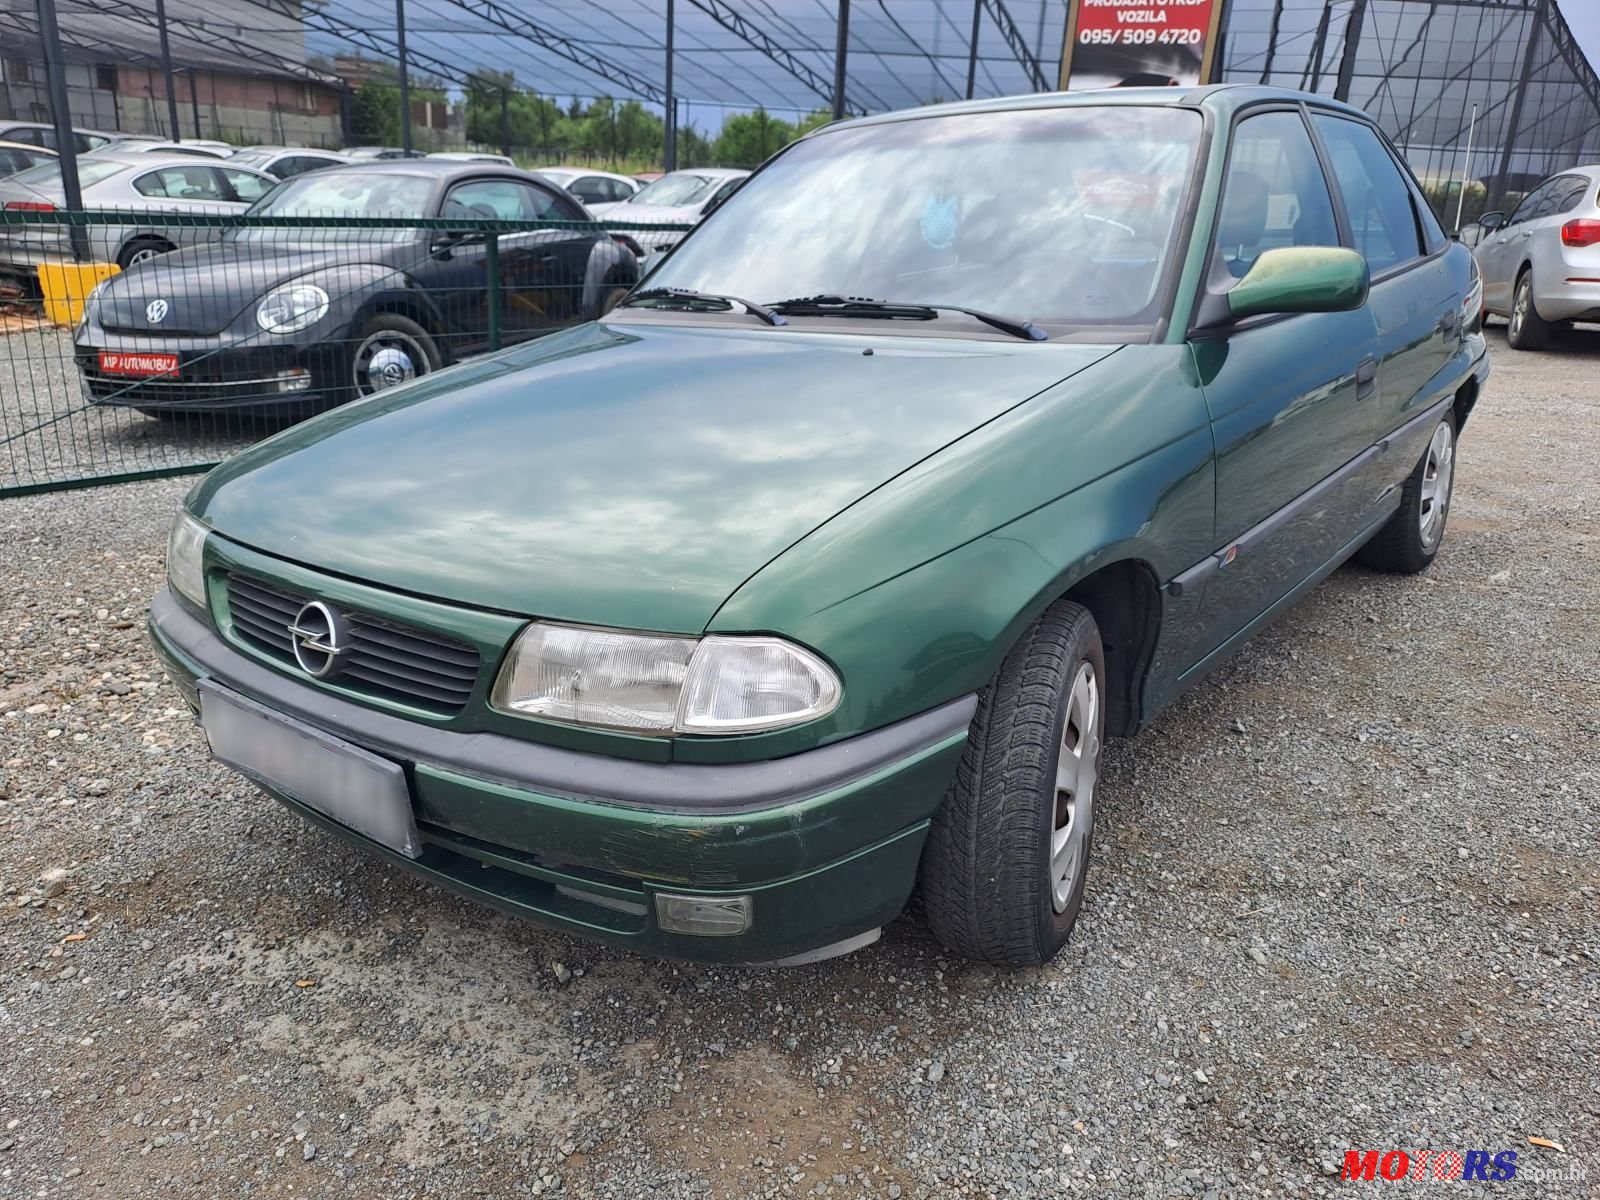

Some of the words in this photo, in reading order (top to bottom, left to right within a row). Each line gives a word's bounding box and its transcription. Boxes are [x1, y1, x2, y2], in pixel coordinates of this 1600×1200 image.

[1116, 10, 1167, 23] VOZILA
[1079, 29, 1120, 44] 095/
[1122, 29, 1156, 44] 509
[1158, 29, 1201, 44] 4720
